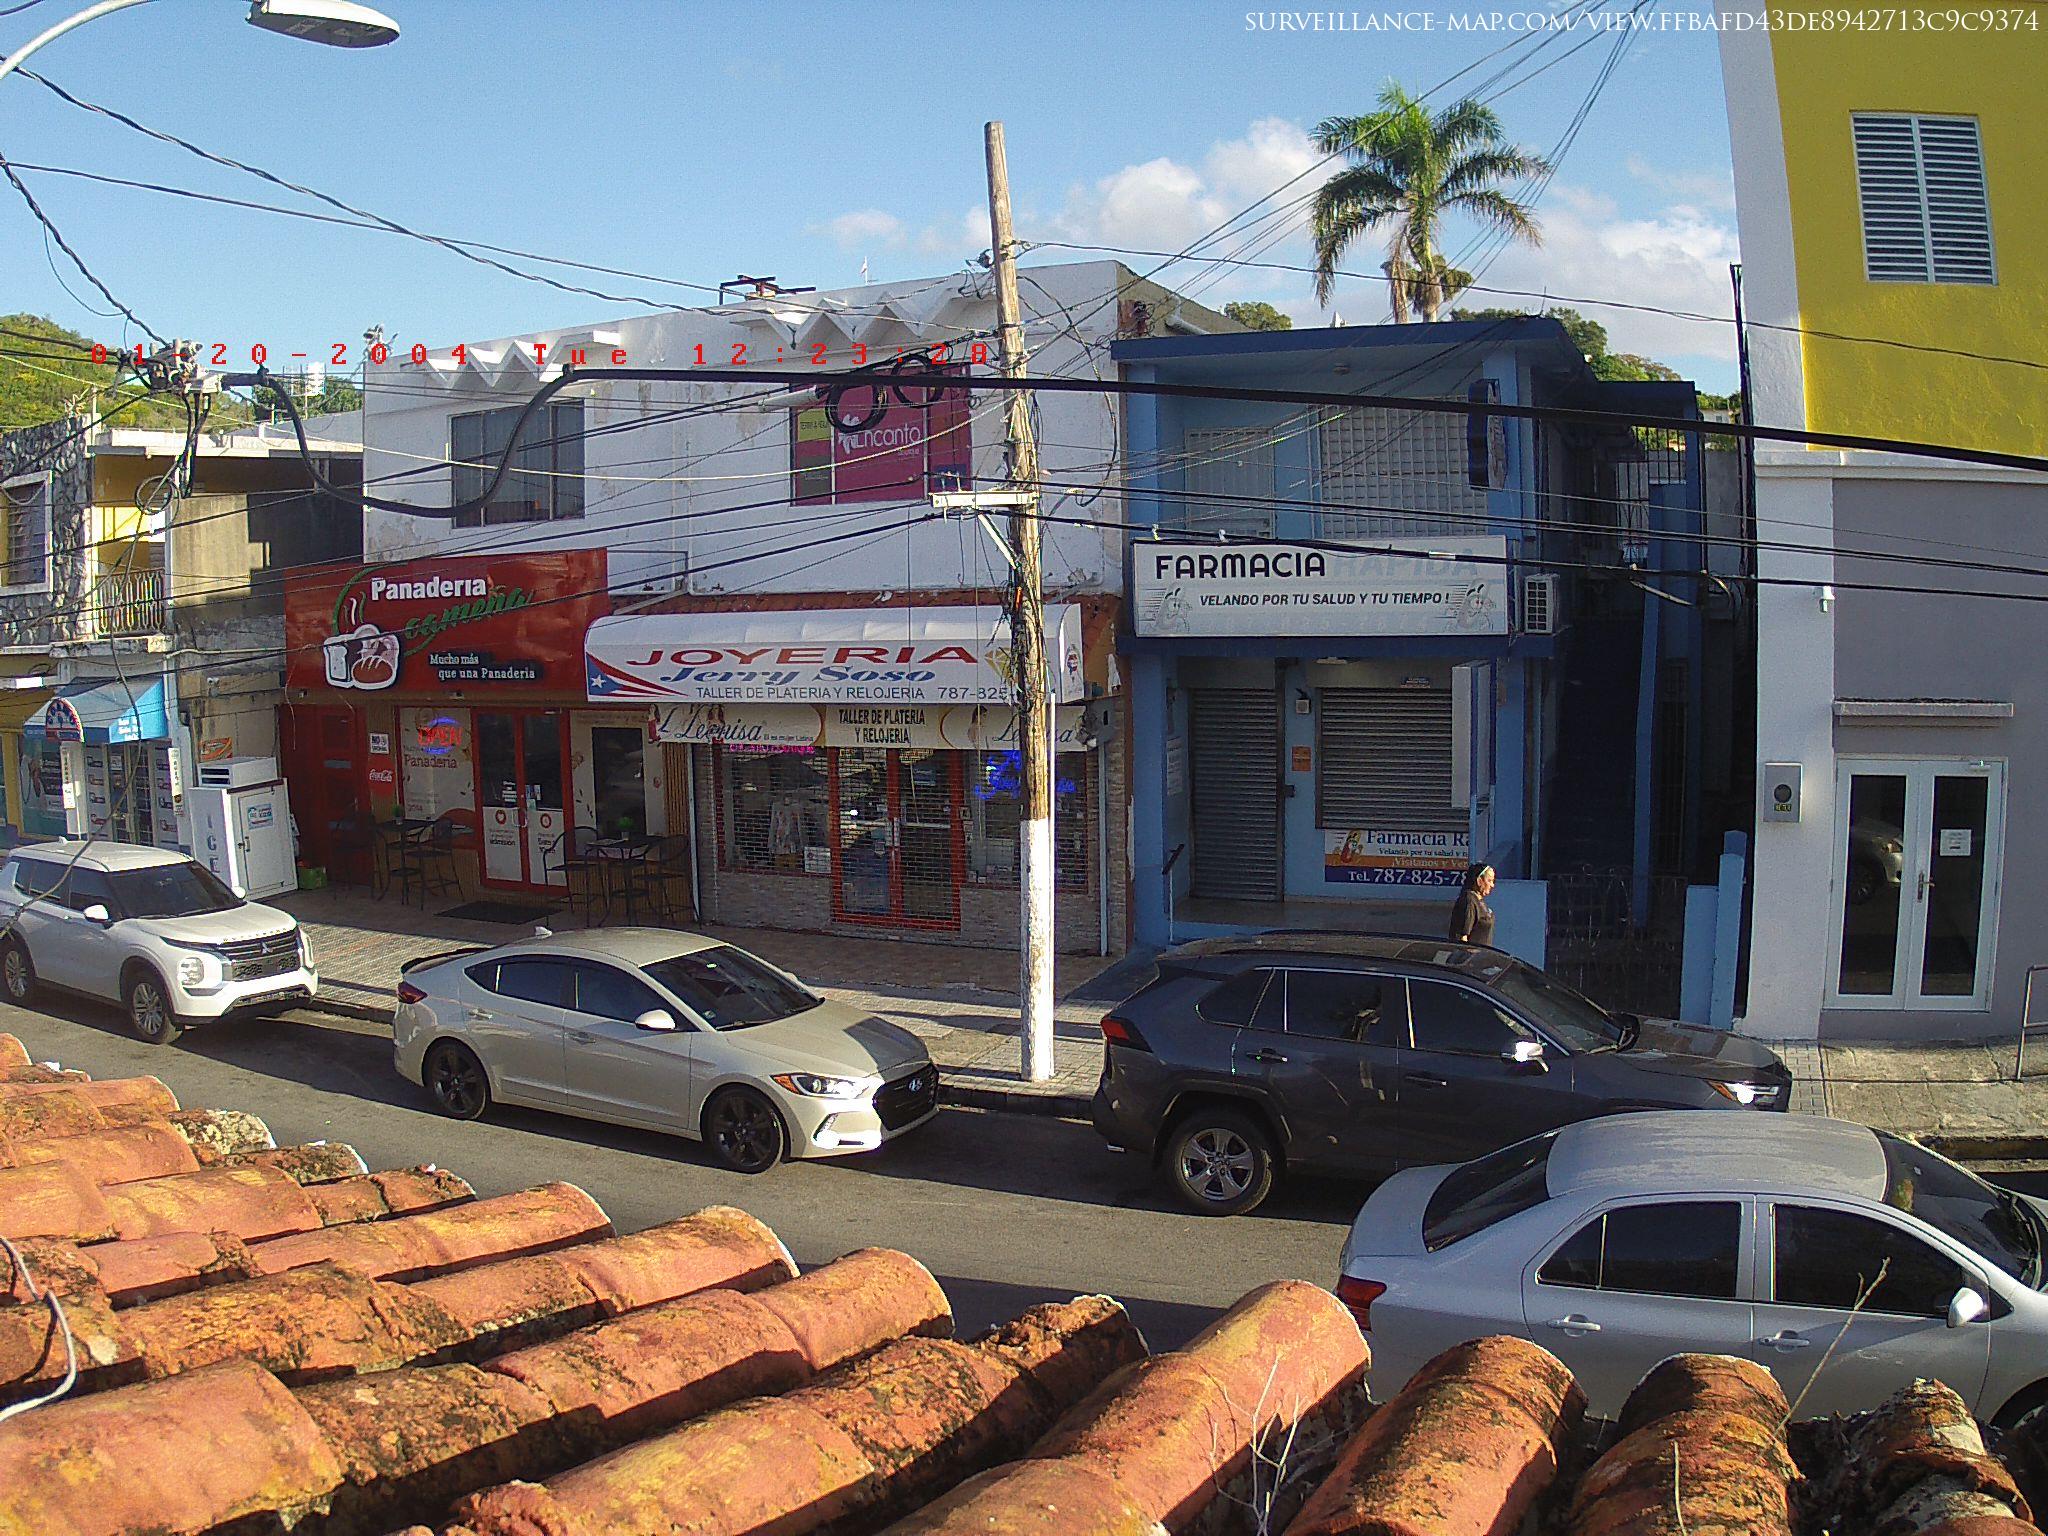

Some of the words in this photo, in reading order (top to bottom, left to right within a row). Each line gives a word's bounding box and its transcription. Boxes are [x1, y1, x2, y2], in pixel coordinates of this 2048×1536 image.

[1155, 552, 1326, 579] FARMACIA
[1199, 595, 1259, 606] VELANDO
[1264, 595, 1289, 606] POR
[1292, 594, 1308, 605] TU
[1312, 594, 1356, 605] SALUD
[1358, 593, 1368, 604] Y
[1371, 593, 1389, 604] TU
[1392, 592, 1442, 604] TIEMPO
[429, 654, 458, 665] Mucho
[625, 646, 978, 666] JOYERIA
[438, 669, 457, 681] que
[459, 669, 479, 679] una
[659, 667, 801, 686] Jerry
[812, 665, 937, 682] Soso
[697, 687, 743, 699] TALLER
[746, 687, 764, 699] DE
[768, 686, 831, 699] PLATERIA
[831, 686, 842, 699] Y
[846, 686, 925, 699] RELOJERIA
[839, 708, 869, 724] TALLER
[871, 709, 882, 724] DE
[884, 709, 926, 725] PLATERIA
[855, 727, 861, 743] Y
[862, 727, 911, 743] RELOJERIA
[1366, 830, 1446, 846] Farmacia
[1373, 868, 1468, 886] 787-825-78
